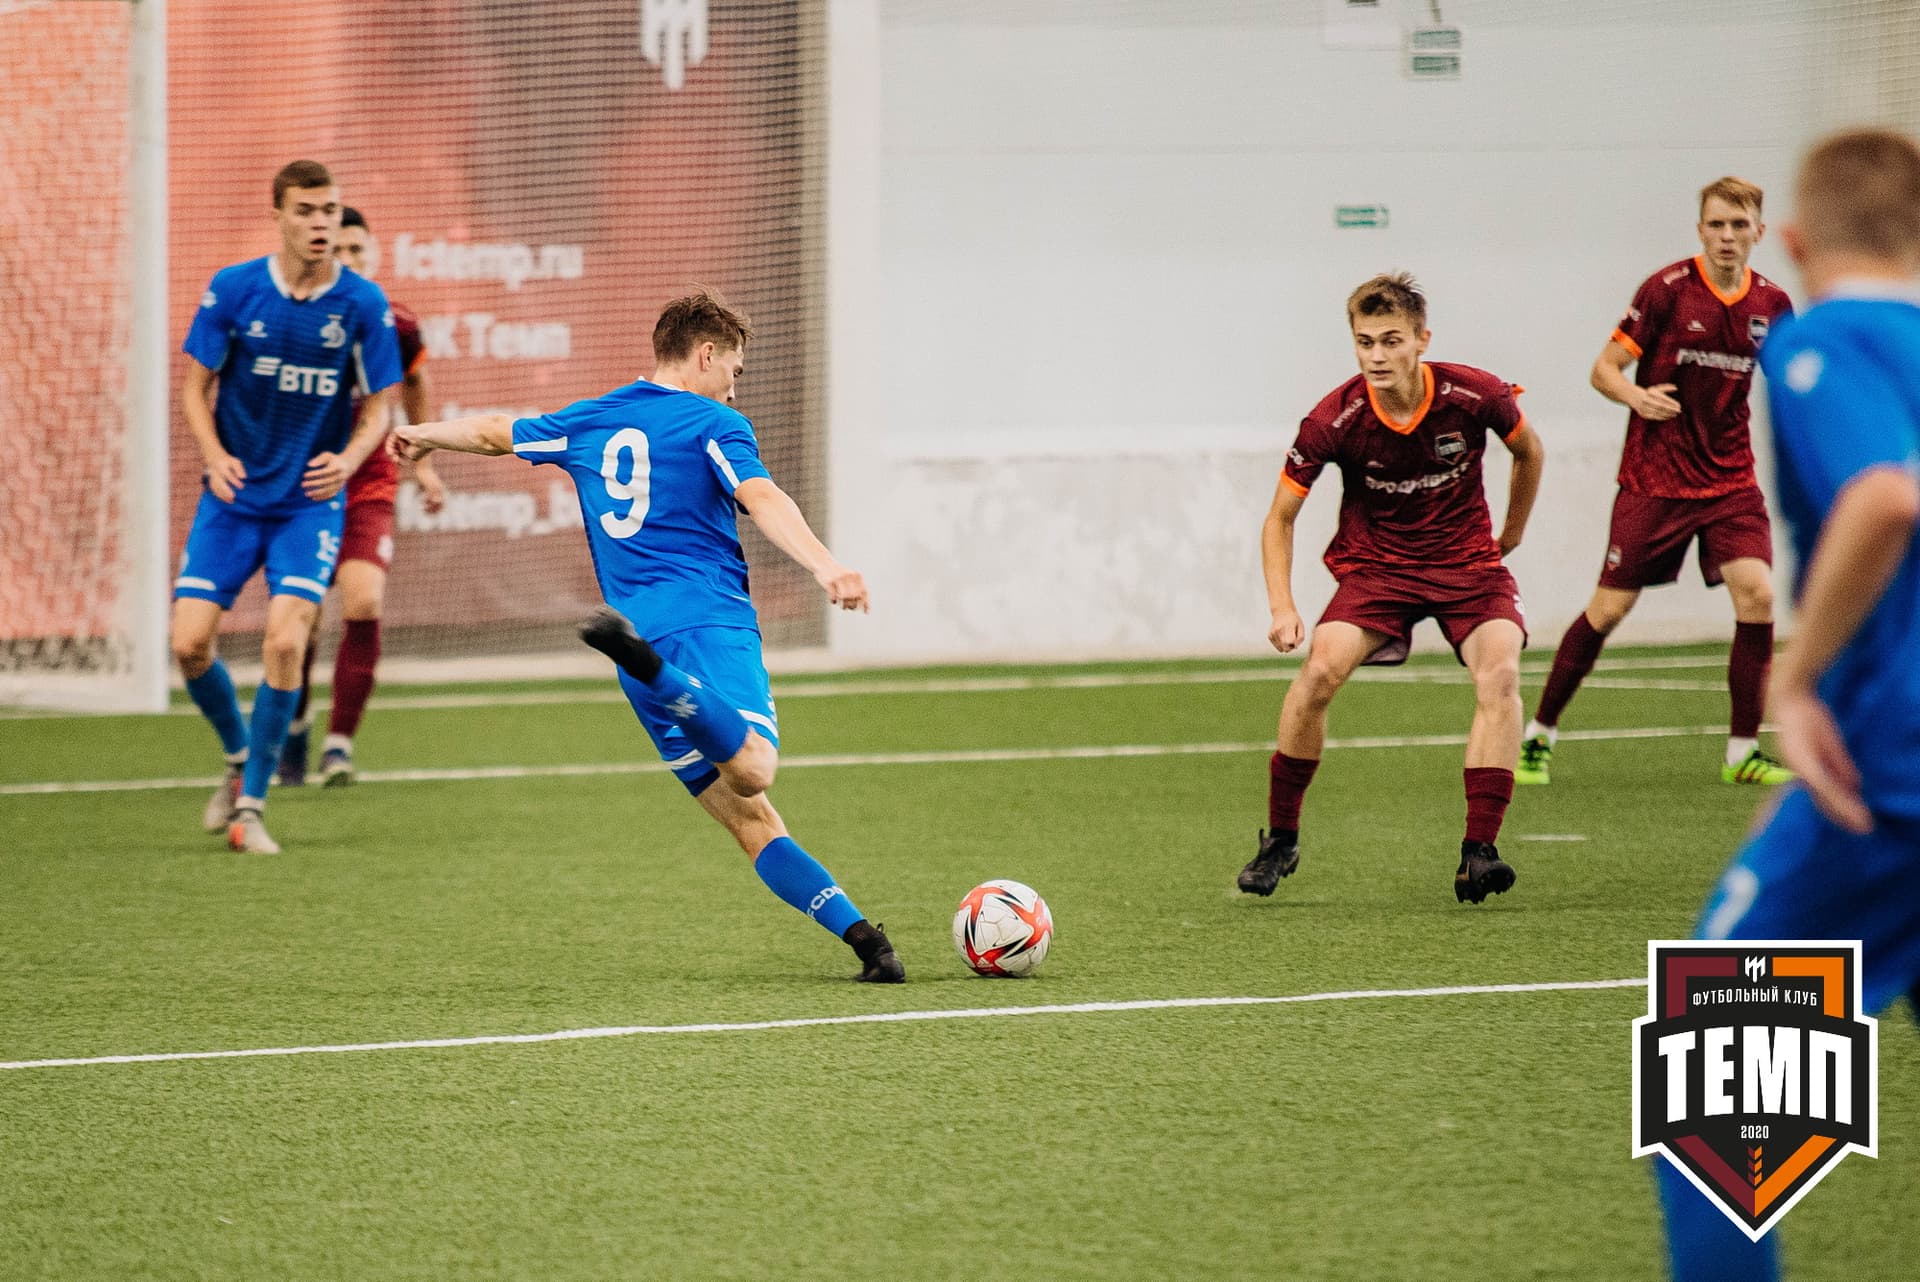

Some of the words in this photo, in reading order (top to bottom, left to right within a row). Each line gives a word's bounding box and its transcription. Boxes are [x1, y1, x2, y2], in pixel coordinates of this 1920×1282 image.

[462, 313, 571, 359] Темп
[278, 364, 339, 397] ВТБ
[600, 428, 651, 539] 9
